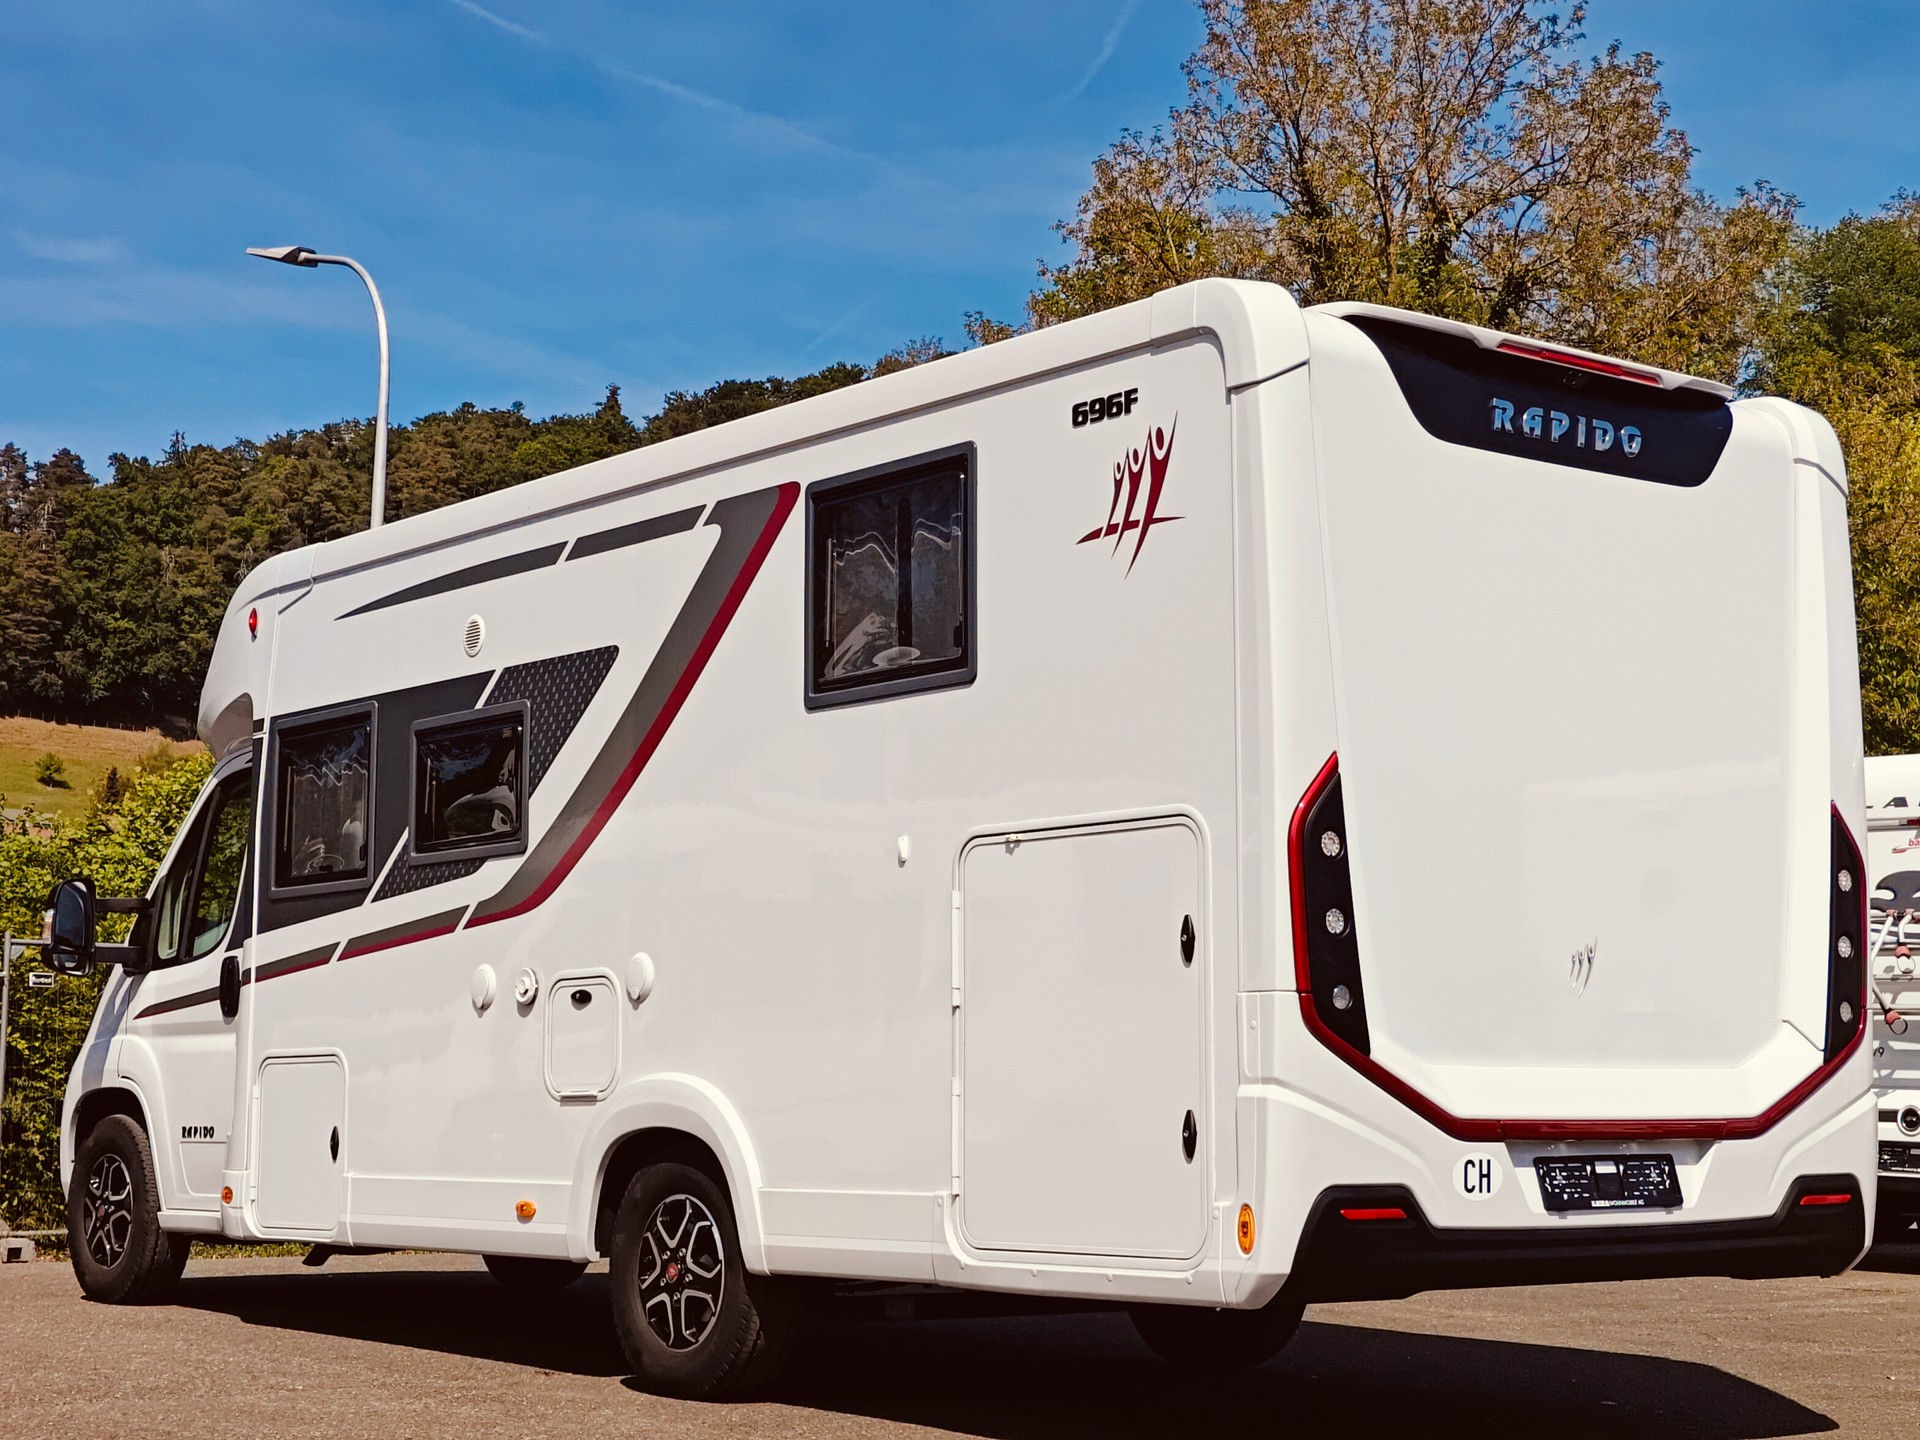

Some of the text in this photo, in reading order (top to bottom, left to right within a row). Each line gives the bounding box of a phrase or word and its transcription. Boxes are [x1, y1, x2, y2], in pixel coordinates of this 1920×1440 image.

[1071, 387, 1138, 429] 696F
[1490, 397, 1642, 458] RAPIDO
[181, 1126, 215, 1139] RAPIDO
[1463, 1159, 1491, 1193] CH
